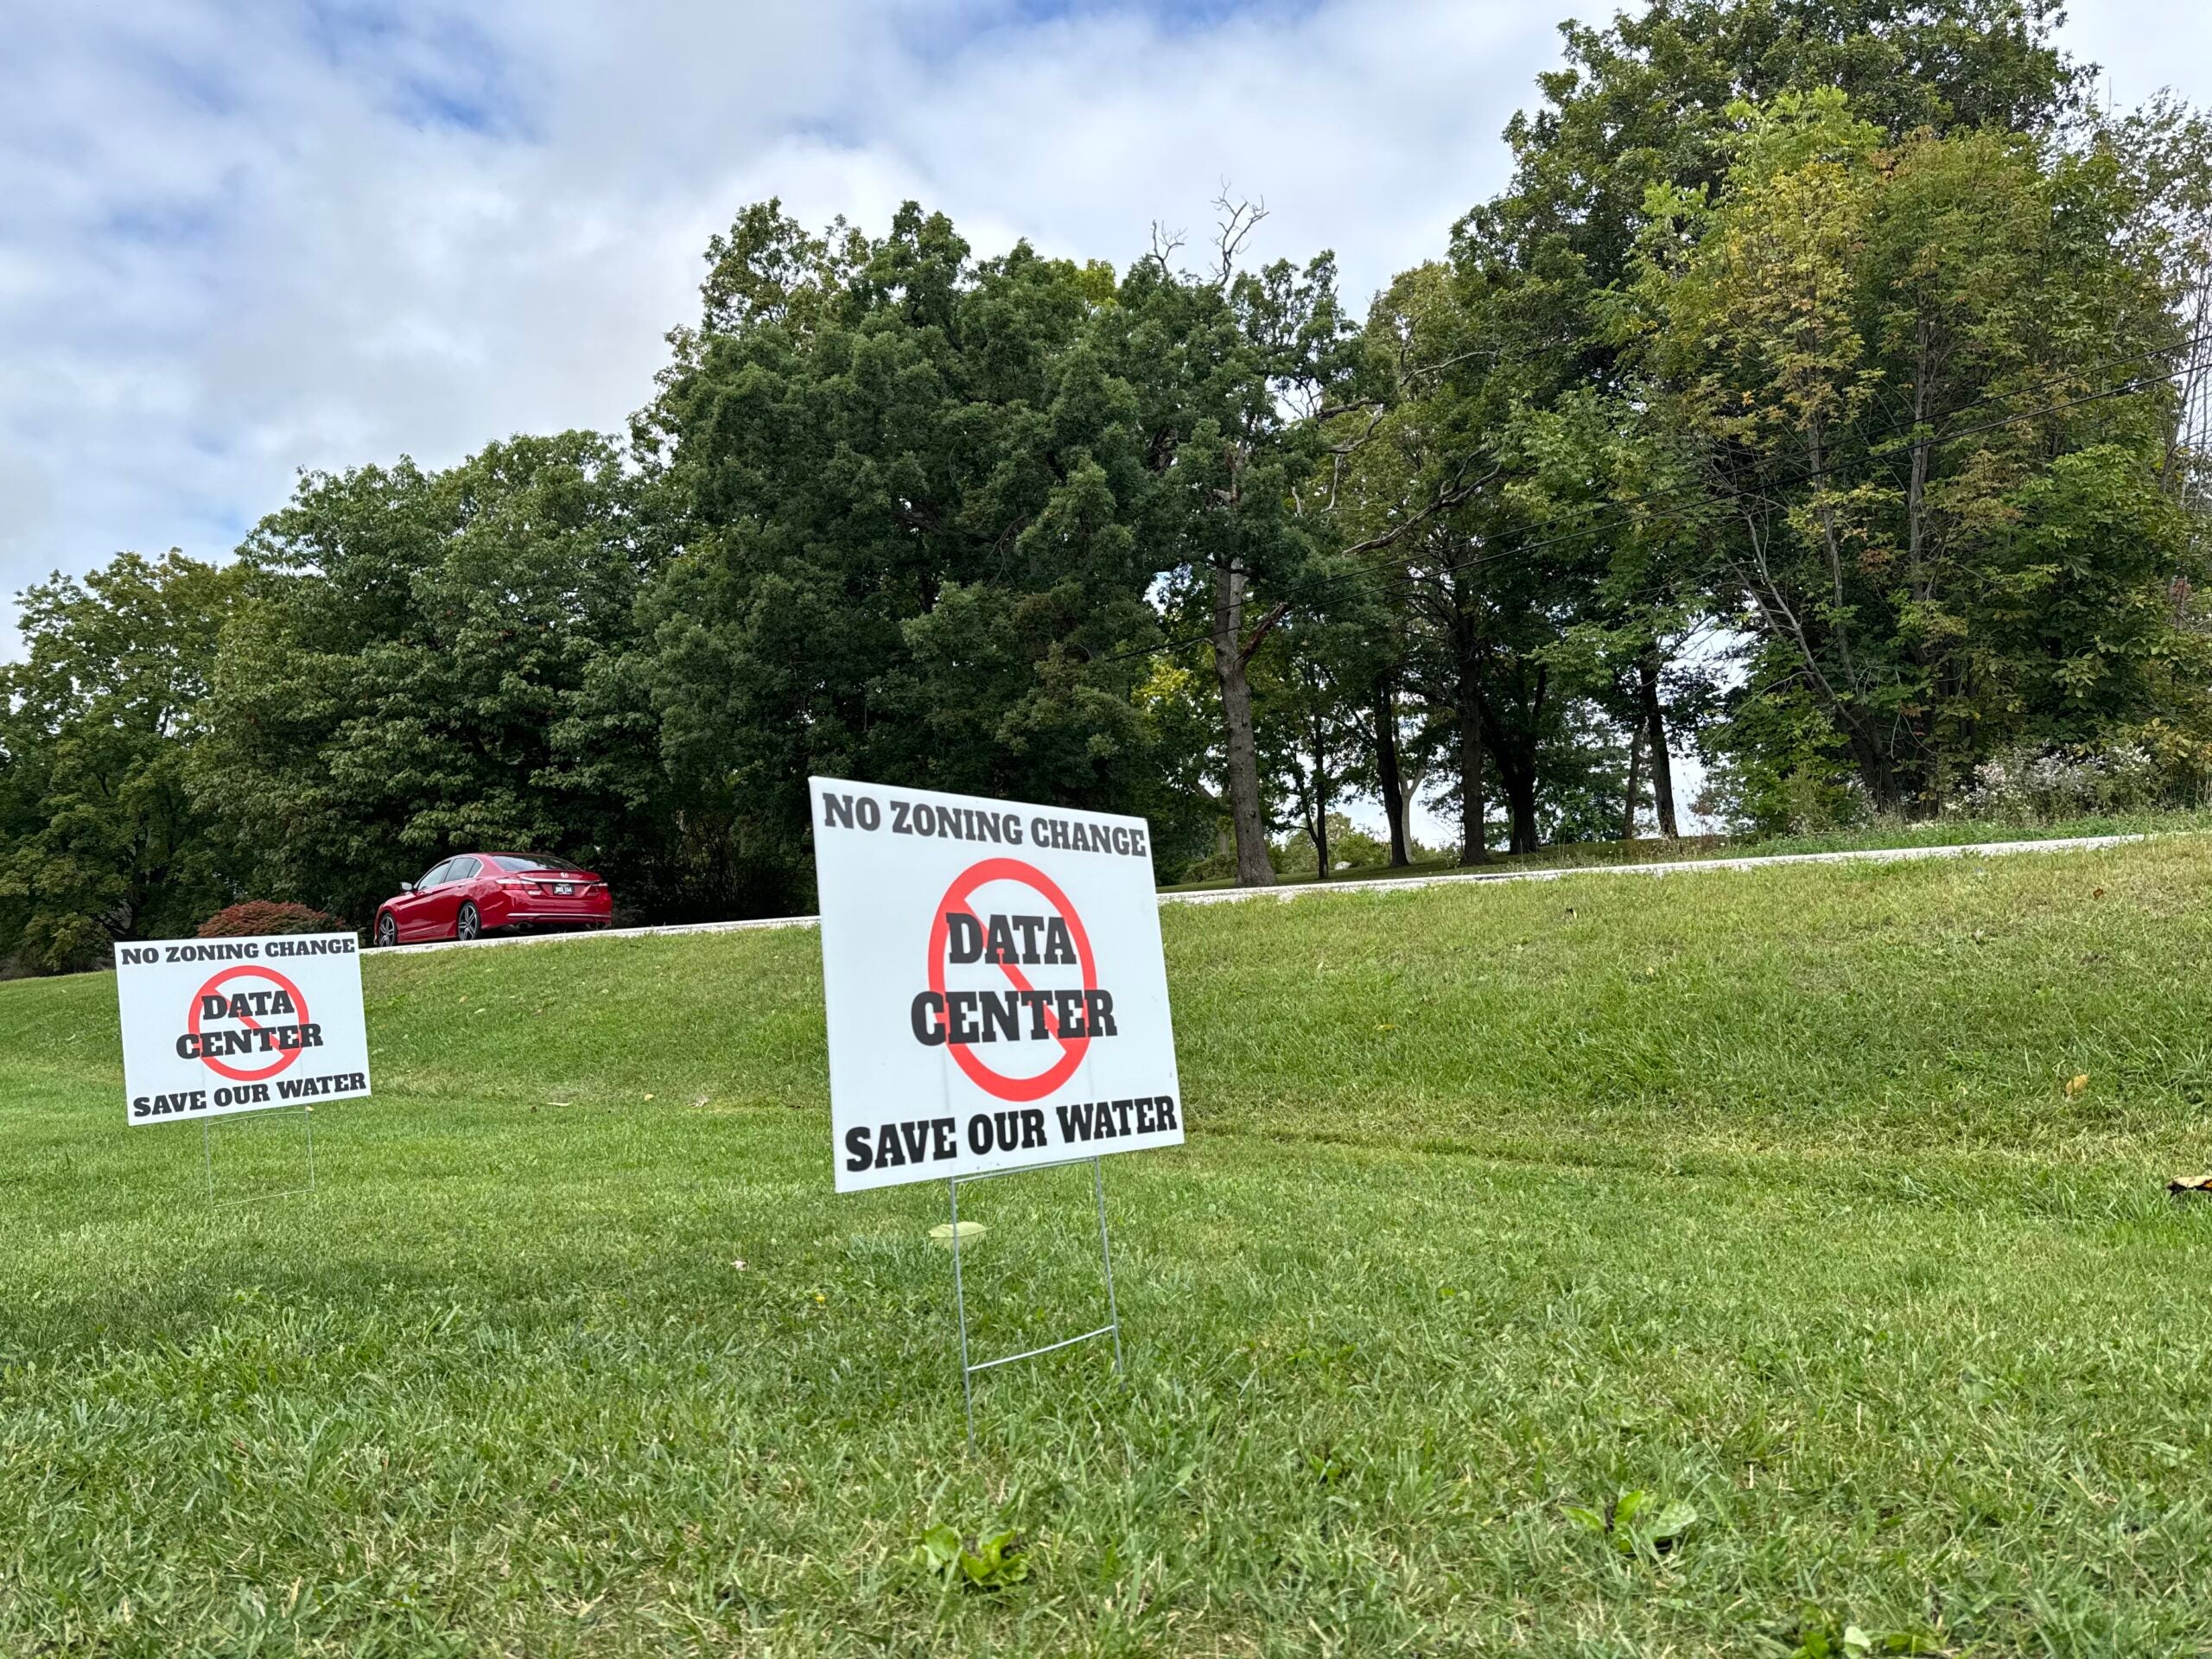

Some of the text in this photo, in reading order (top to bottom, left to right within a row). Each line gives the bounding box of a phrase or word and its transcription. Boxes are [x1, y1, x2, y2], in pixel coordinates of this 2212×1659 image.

[822, 792, 1147, 857] NO ZONING CHANGE
[121, 938, 355, 965] NO ZONING CHANGE
[945, 912, 1077, 965] DATA
[201, 989, 296, 1020] DATA
[911, 988, 1118, 1046] CENTER
[175, 1023, 324, 1059] CENTER
[133, 1071, 366, 1117] SAVE OUR WATER
[845, 1095, 1178, 1173] SAVE OUR WATER
